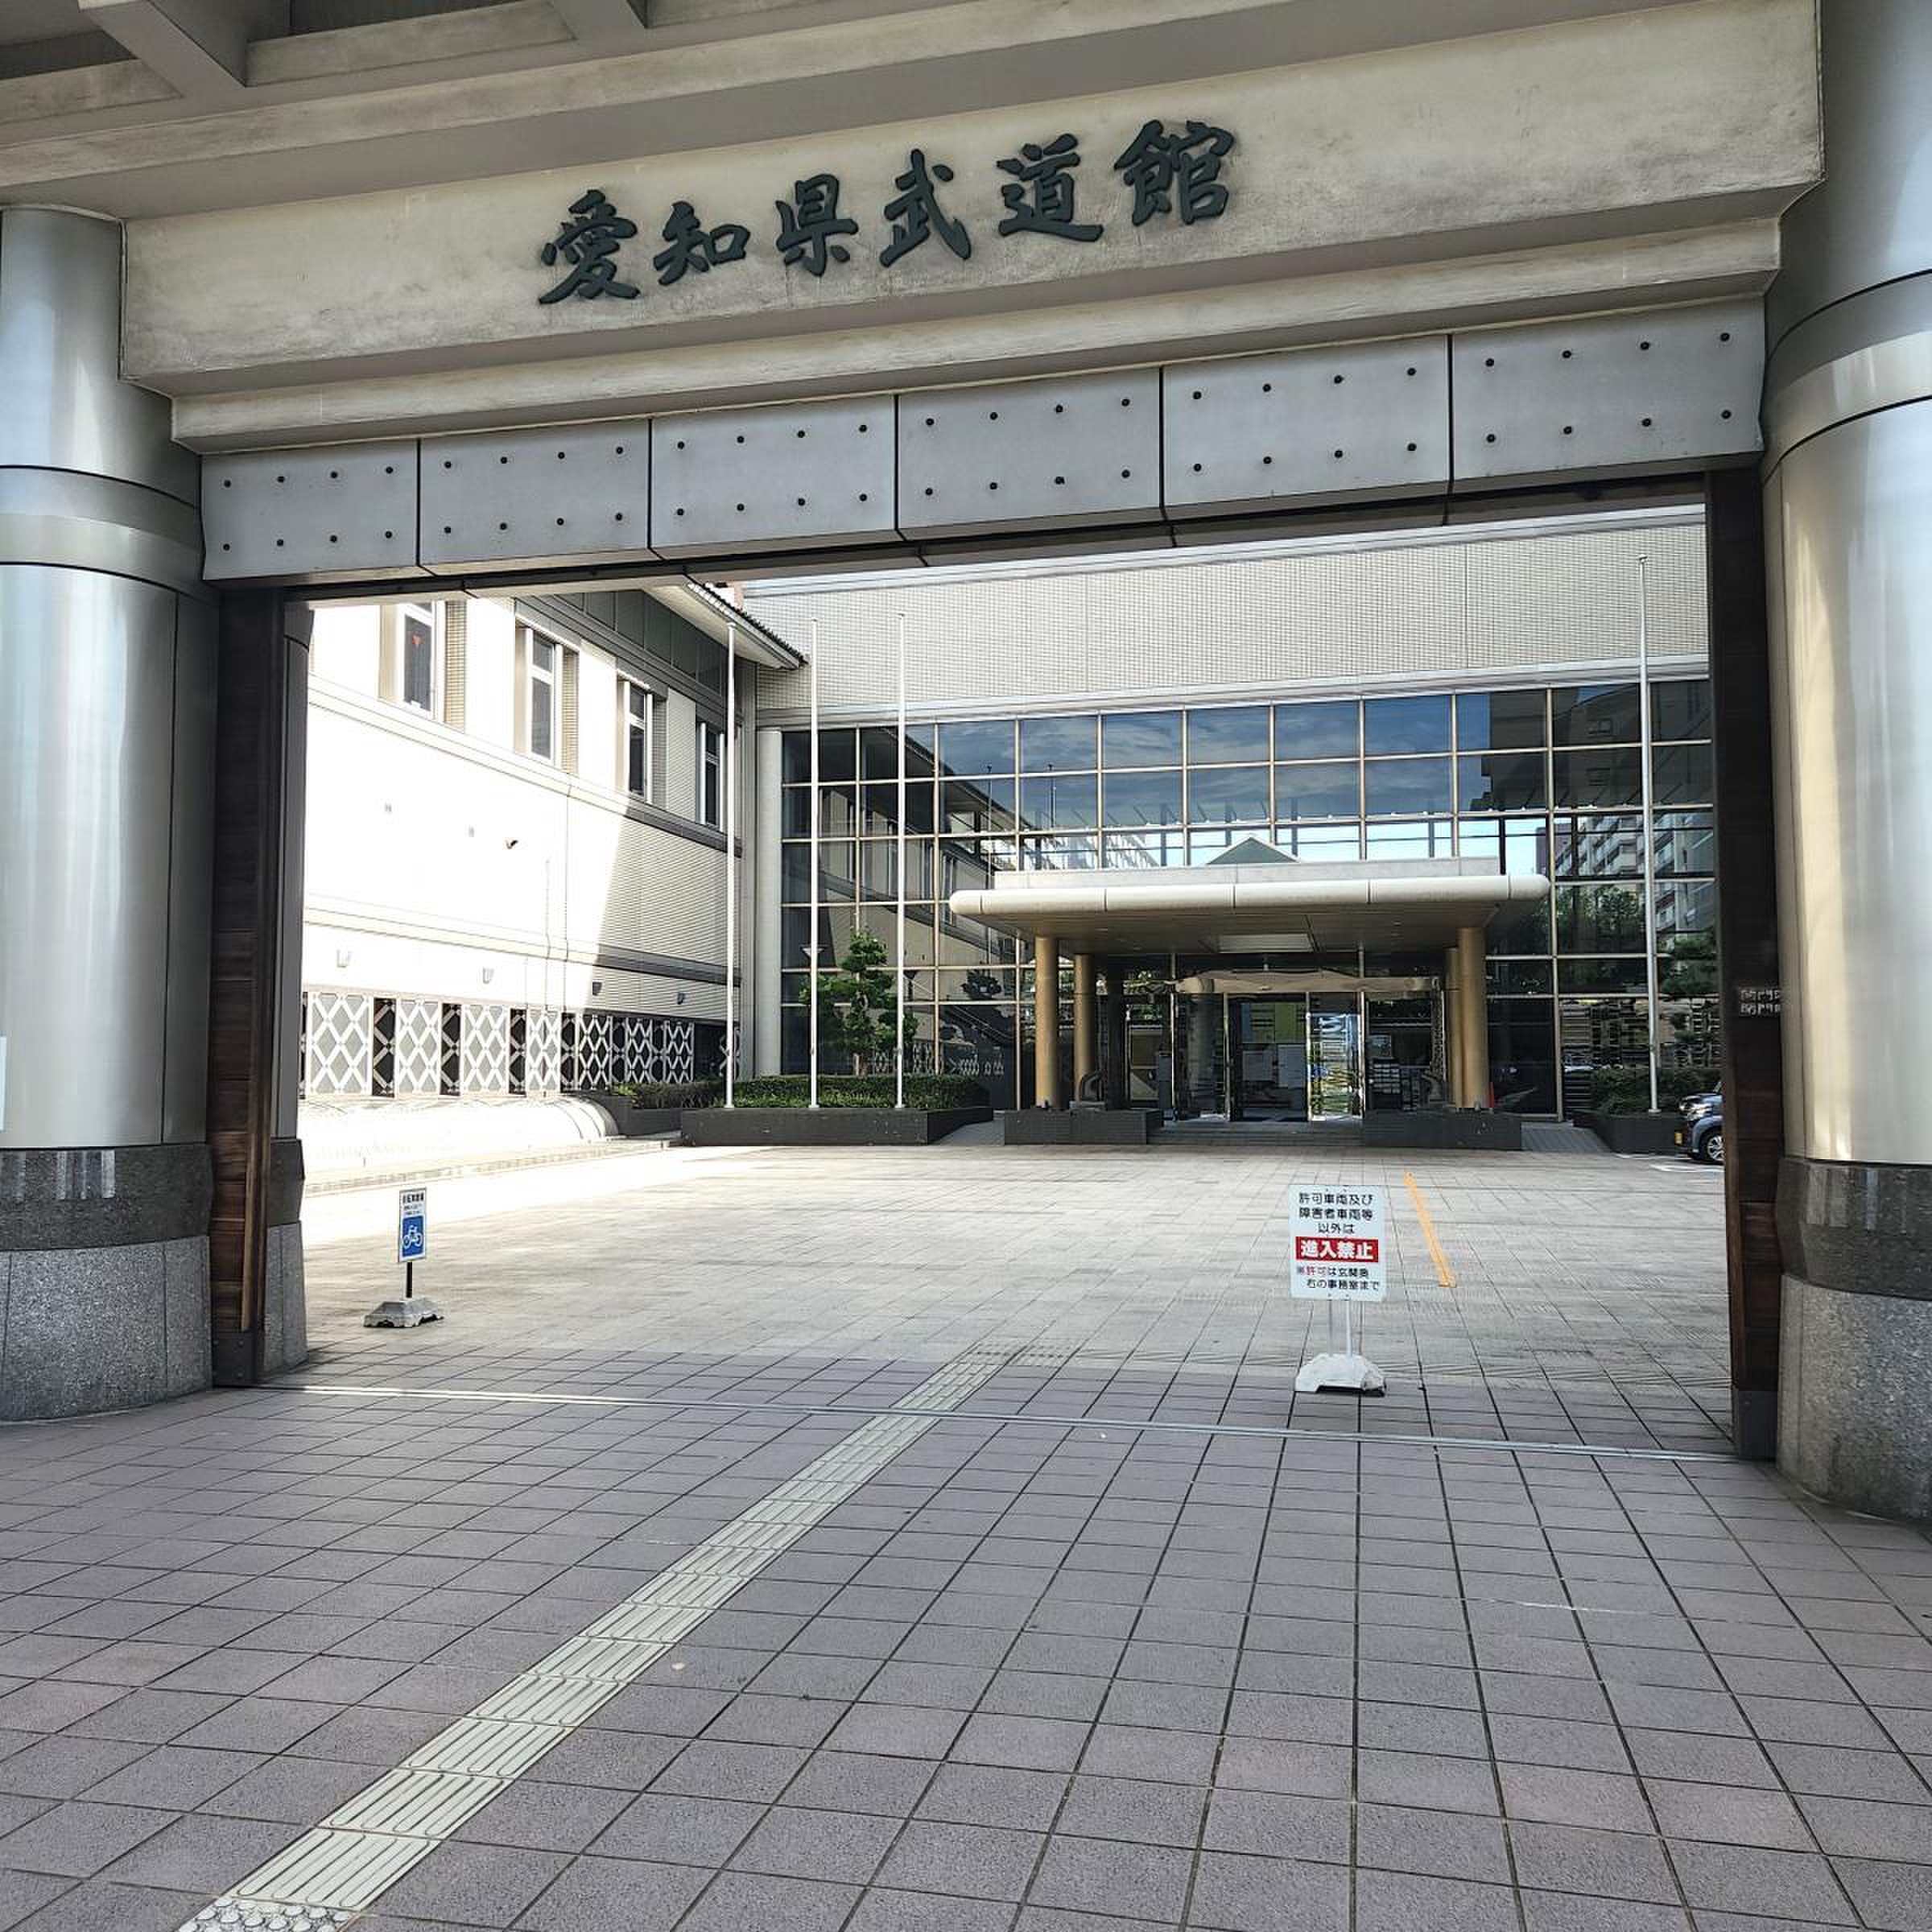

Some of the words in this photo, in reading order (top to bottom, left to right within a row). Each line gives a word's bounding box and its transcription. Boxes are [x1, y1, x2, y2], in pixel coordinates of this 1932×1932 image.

[538, 118, 1236, 305] 愛知県武道館
[1319, 1223, 1355, 1234] 以外は
[1301, 1241, 1373, 1260] 進入禁止
